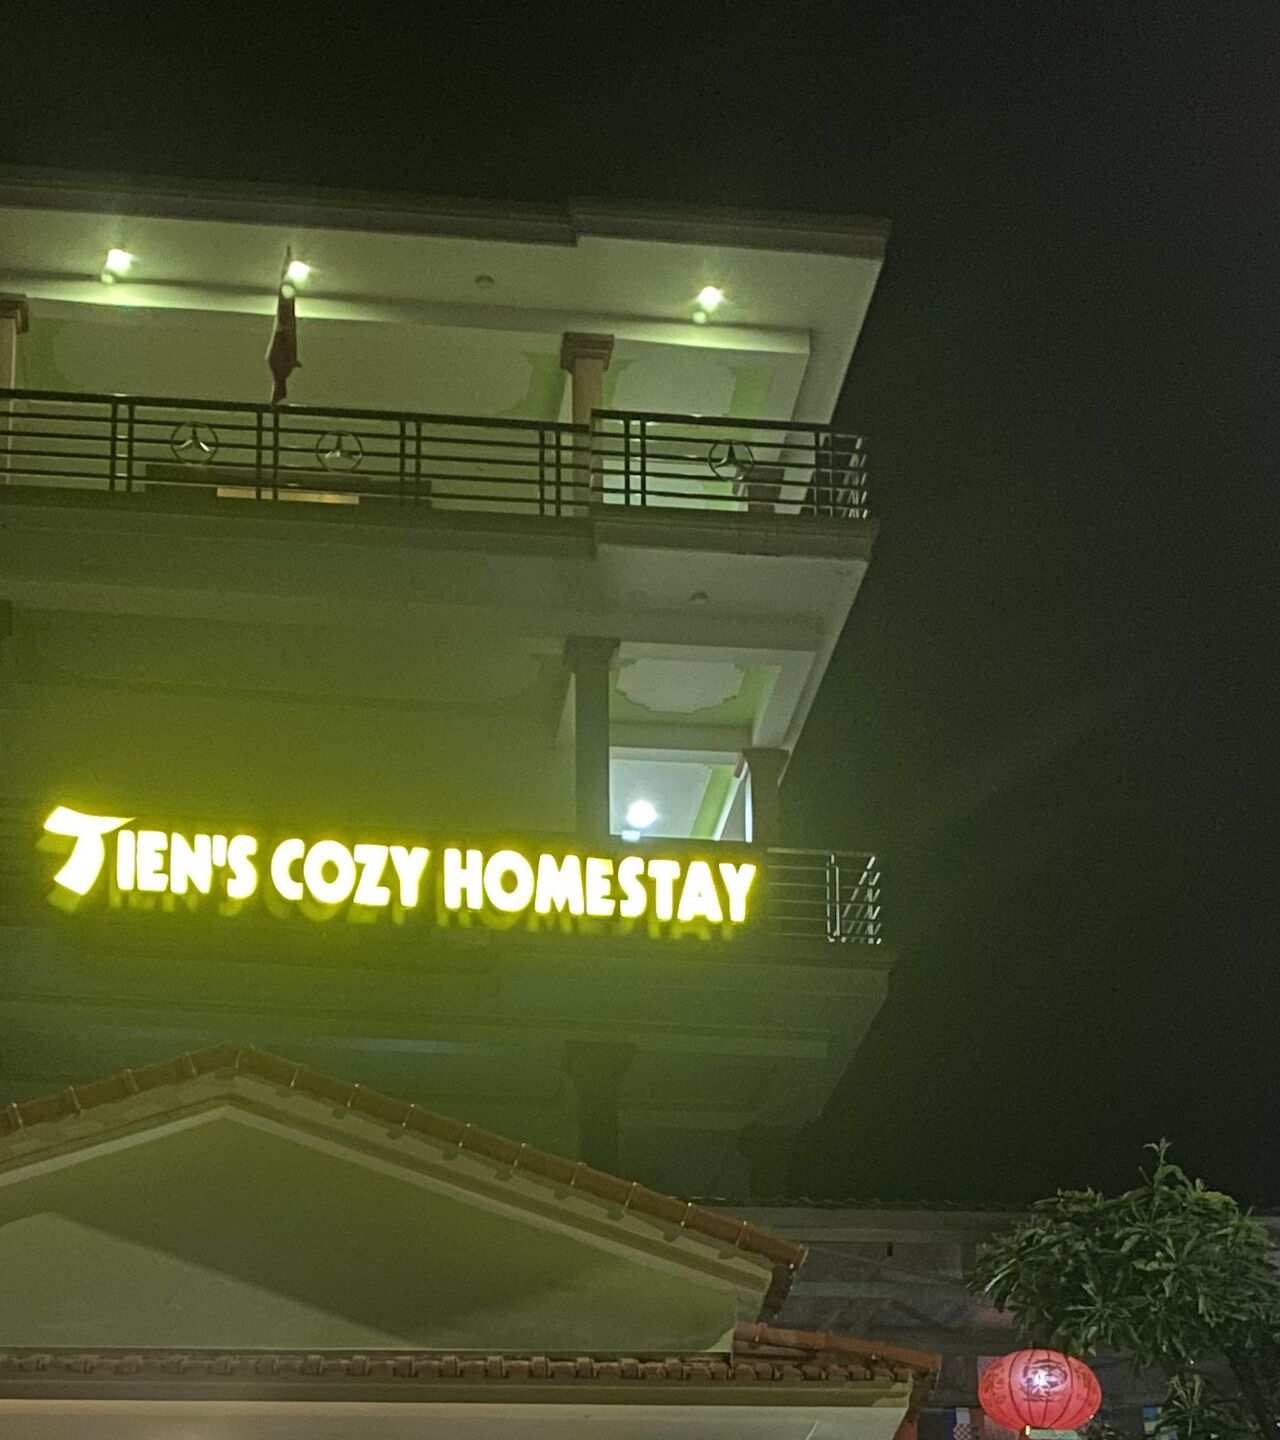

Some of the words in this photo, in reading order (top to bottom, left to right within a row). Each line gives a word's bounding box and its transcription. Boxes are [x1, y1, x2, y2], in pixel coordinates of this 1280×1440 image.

[43, 806, 258, 899] TIEN'S
[271, 838, 430, 907] COZY
[444, 847, 757, 923] HOMESTAY
